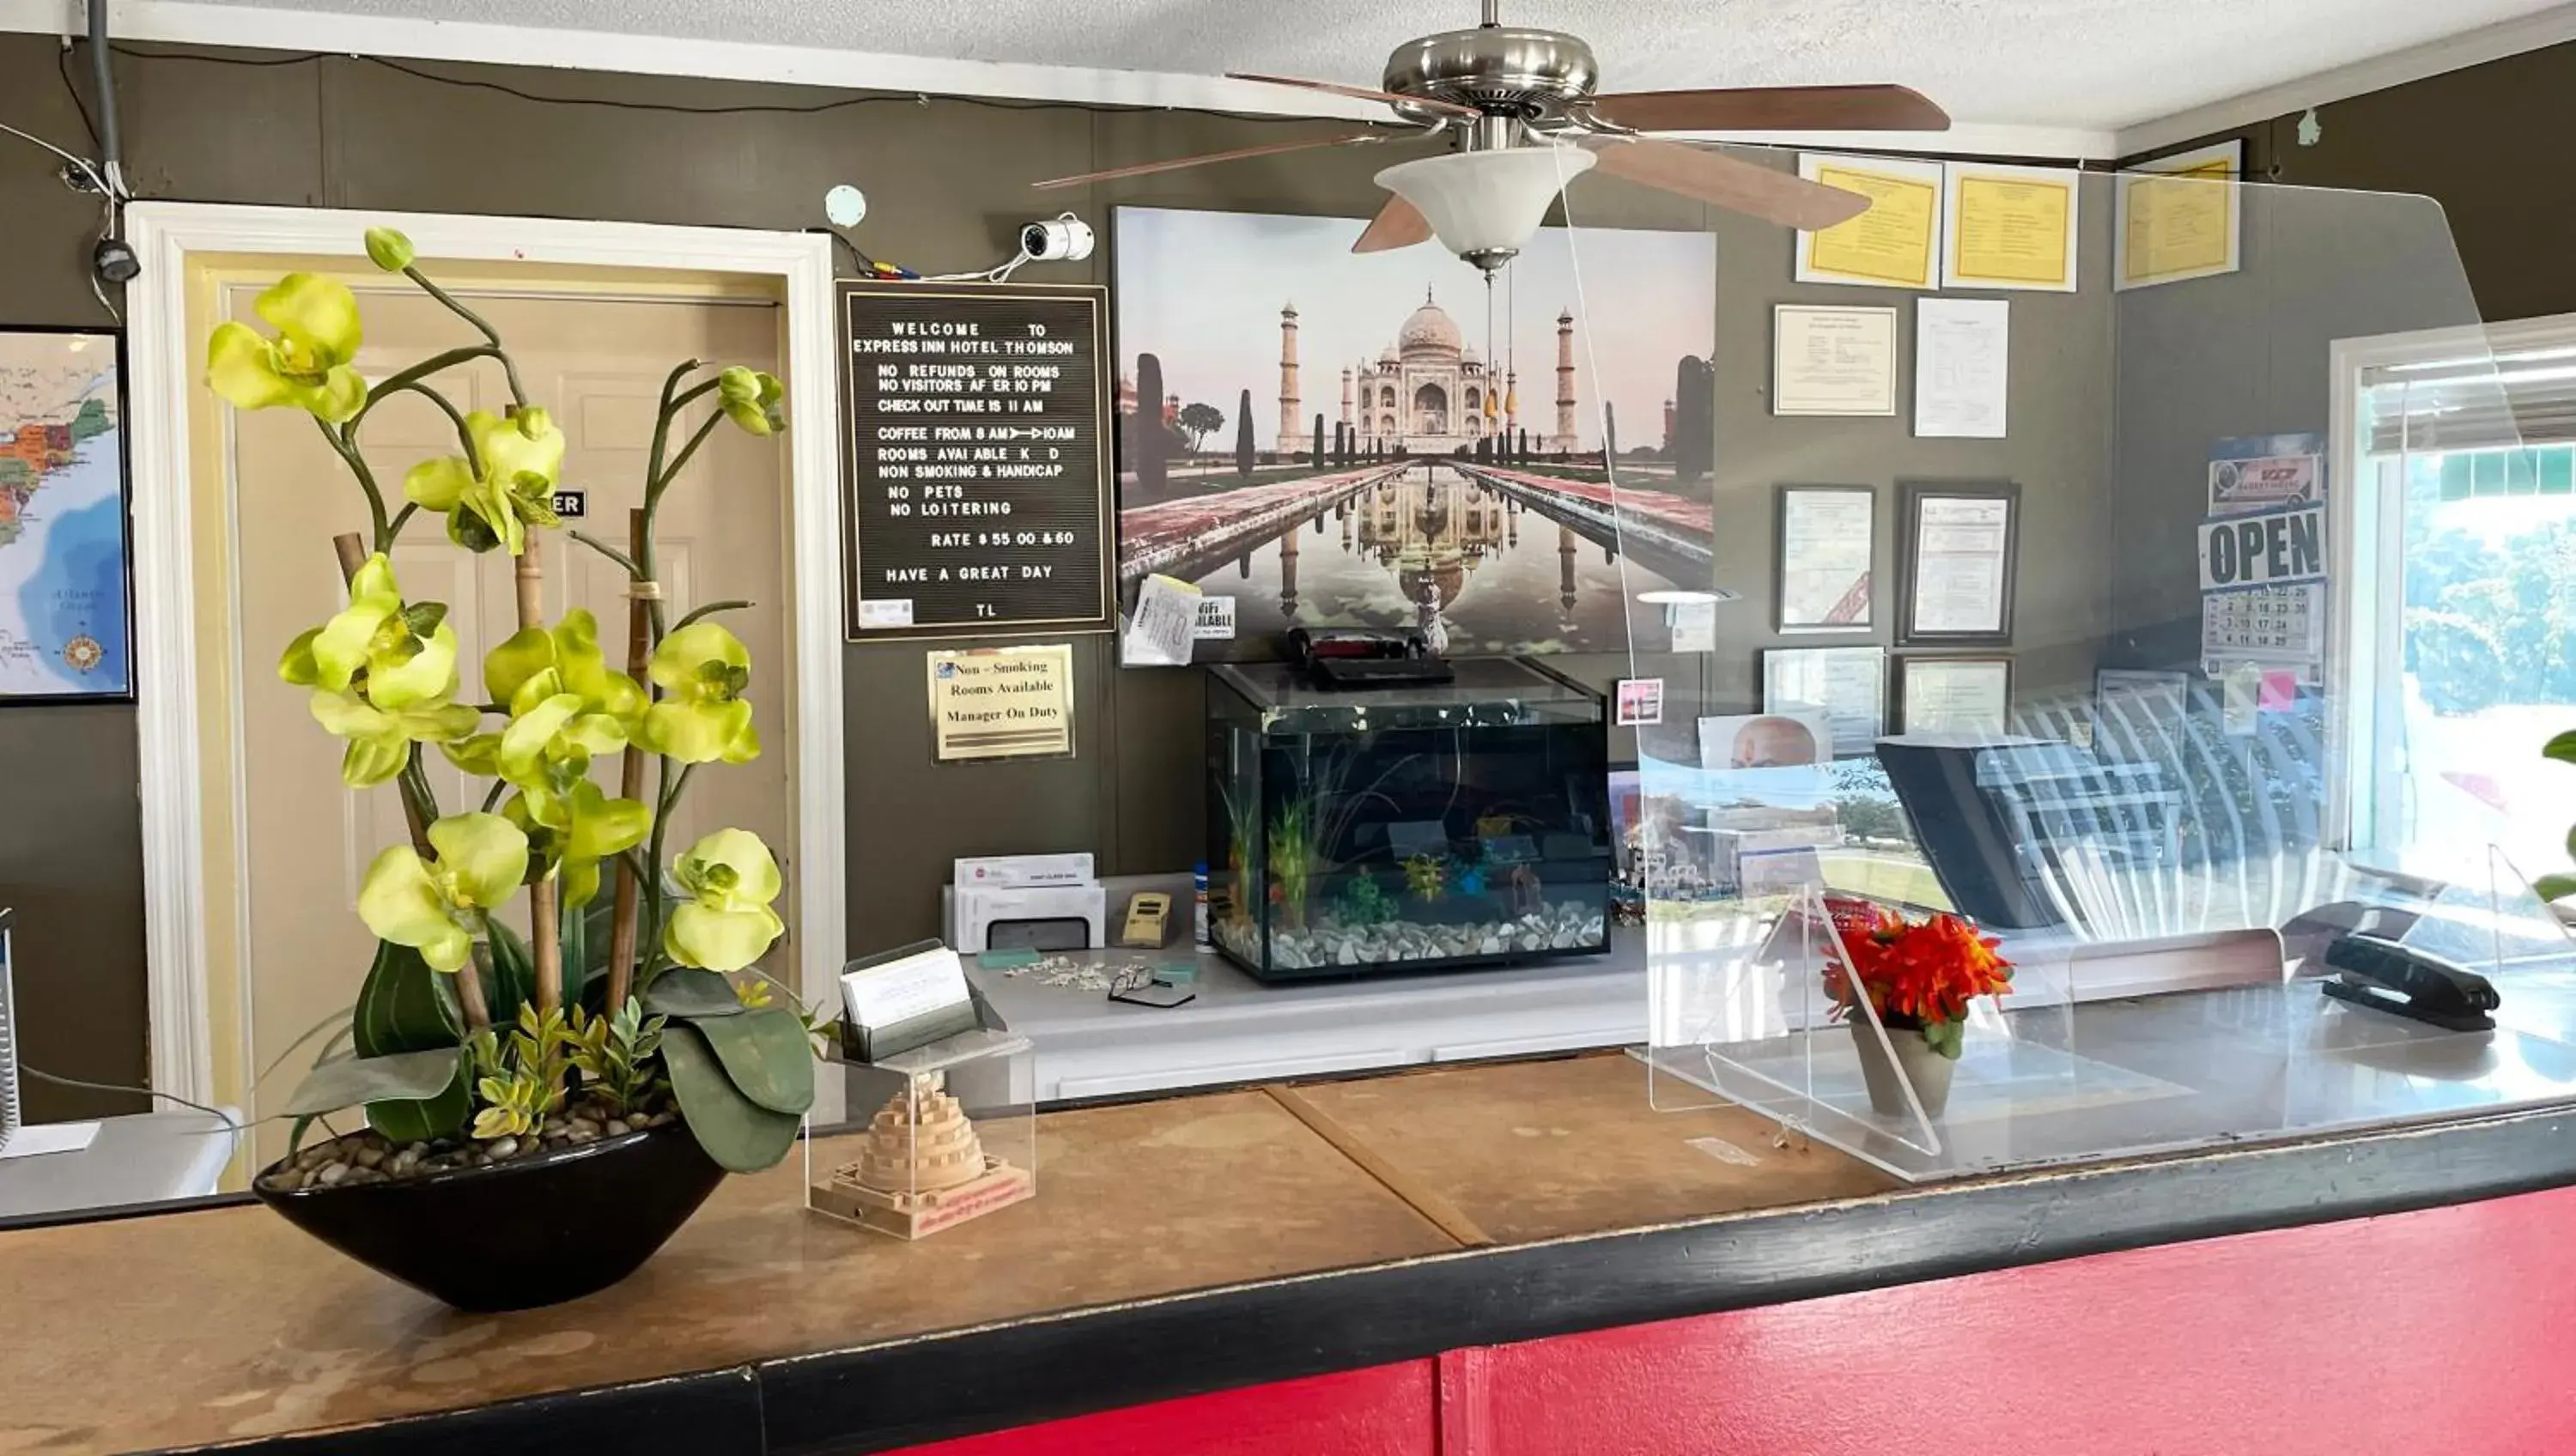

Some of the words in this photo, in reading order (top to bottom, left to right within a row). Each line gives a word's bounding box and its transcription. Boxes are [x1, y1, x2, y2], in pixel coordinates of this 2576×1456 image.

[892, 323, 978, 336] WELCOME
[1029, 325, 1045, 337] TO
[854, 340, 918, 353] EXPRESS
[922, 341, 945, 352] INN
[951, 341, 998, 353] HOTEL
[1005, 342, 1072, 354] THOMSON
[879, 365, 897, 377] NO
[910, 365, 975, 378] REFUNDS
[989, 366, 1006, 378] ON
[1014, 366, 1060, 378] ROOMS
[879, 379, 898, 391] NO
[902, 379, 962, 391] VISITORS
[1032, 379, 1050, 391] PM
[878, 399, 920, 411] CHECK
[924, 400, 950, 412] OUT
[953, 400, 984, 412] TIME
[989, 400, 1001, 412] IS
[1024, 400, 1042, 412] AM
[878, 428, 927, 440] COFFEE
[936, 428, 971, 440] FROM
[976, 428, 984, 440] 8
[989, 428, 1008, 439] AM
[878, 448, 927, 461] ROOMS
[1021, 448, 1029, 459] K
[1049, 448, 1058, 458] D
[879, 465, 908, 477] NON
[915, 465, 976, 477] SMOKING
[983, 465, 991, 477] &
[997, 465, 1062, 477] HANDICAP
[889, 486, 908, 498] NO
[925, 486, 962, 498] PETS
[553, 496, 578, 513] ER
[891, 504, 910, 515] NO
[921, 502, 1011, 515] LOITERING
[932, 534, 970, 546] RATE
[1017, 533, 1036, 544] 00
[2210, 513, 2320, 583] OPEN
[887, 568, 927, 581] HAVE
[939, 568, 948, 580] A
[959, 567, 1008, 579] GREAT
[1023, 567, 1051, 577] DAY
[1195, 615, 1231, 626] ILABLE
[957, 664, 980, 675] Non
[993, 662, 1048, 674] Smoking
[951, 685, 993, 695] Rooms
[998, 681, 1053, 693] Available
[948, 711, 1001, 722] Manager
[1006, 707, 1025, 719] On
[1030, 707, 1057, 719] Duty
